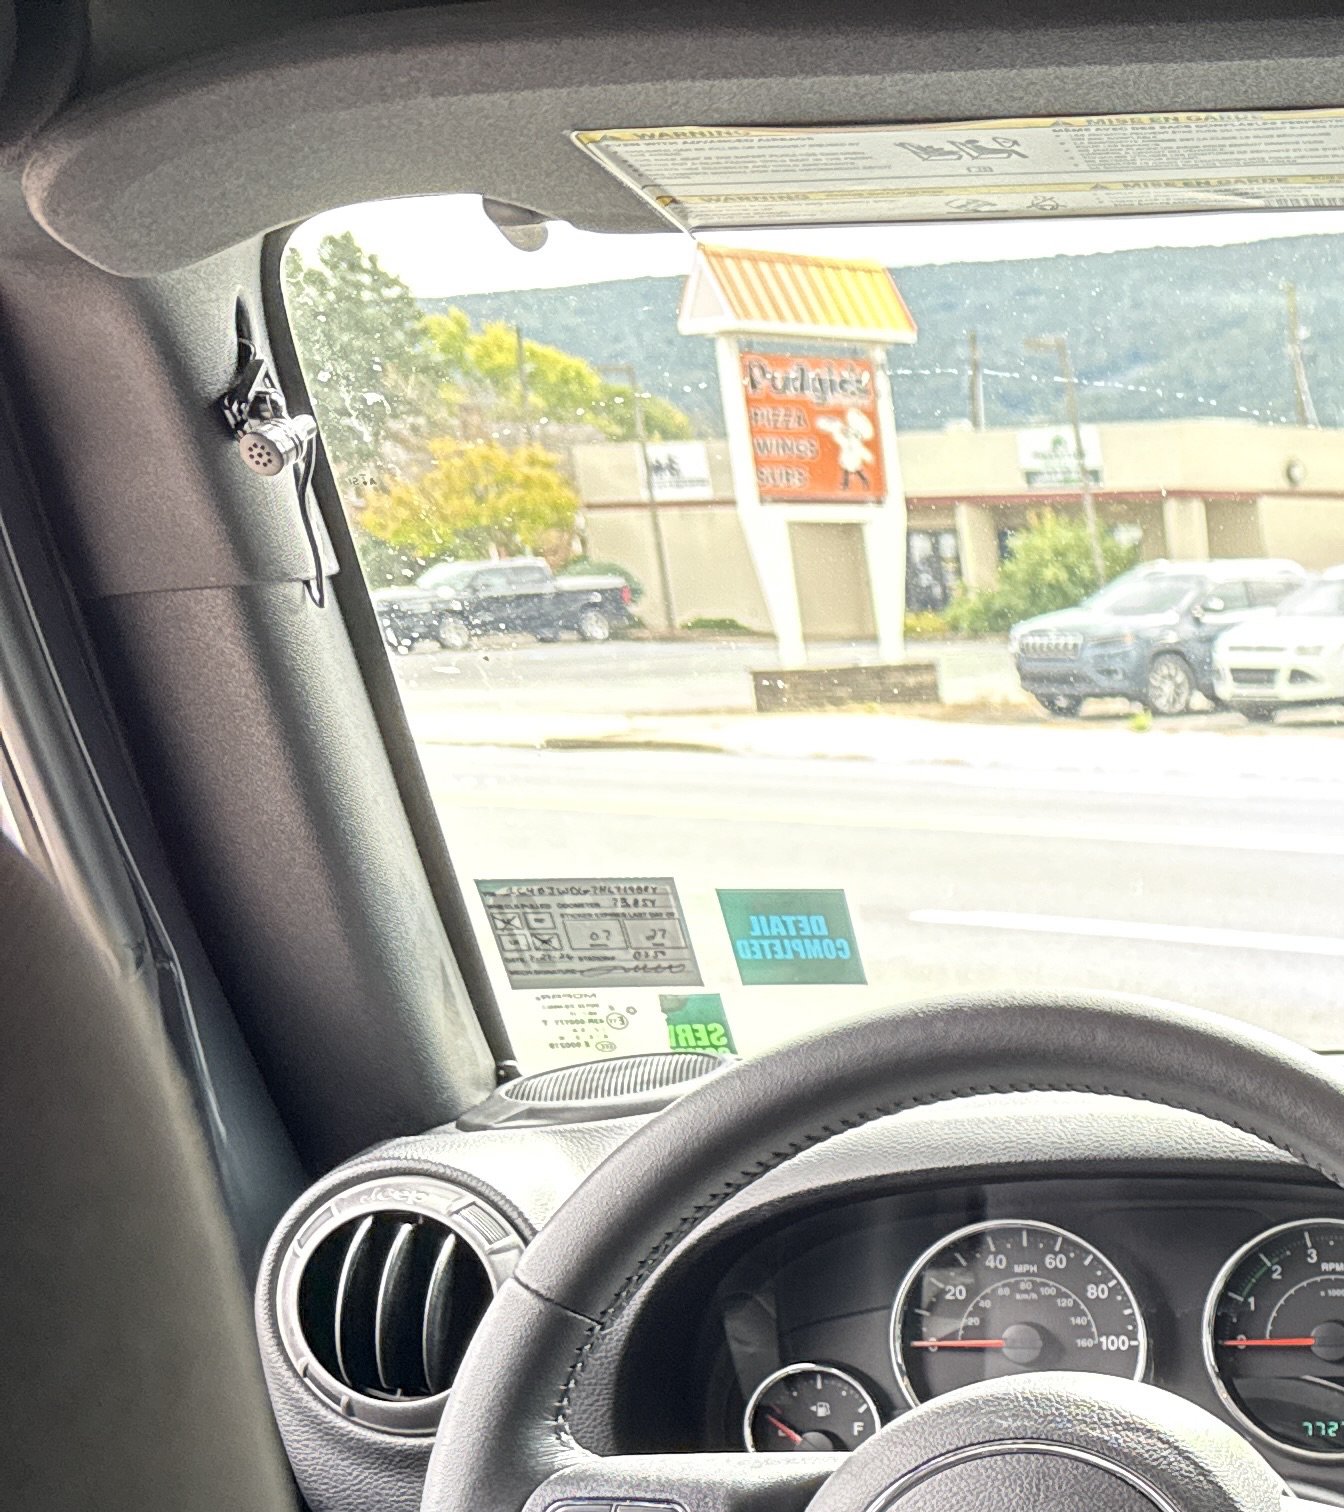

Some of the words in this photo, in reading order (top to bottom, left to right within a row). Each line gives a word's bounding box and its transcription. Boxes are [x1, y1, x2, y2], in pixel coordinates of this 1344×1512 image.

[755, 436, 818, 459] WINGS
[985, 1254, 1007, 1269] 40
[1045, 1254, 1067, 1269] 60
[1307, 1250, 1318, 1263] 3
[1014, 1264, 1038, 1274] MPH
[1271, 1265, 1282, 1280] 2
[1320, 1262, 1344, 1273] RPM
[945, 1284, 966, 1300] 20
[1087, 1284, 1109, 1299] 80
[1056, 1298, 1074, 1308] 120
[1248, 1297, 1255, 1311] 1
[967, 1316, 980, 1326] 20
[1070, 1316, 1088, 1326] 140
[1076, 1338, 1094, 1348] 160
[1099, 1335, 1130, 1351] 100
[853, 1421, 865, 1436] F
